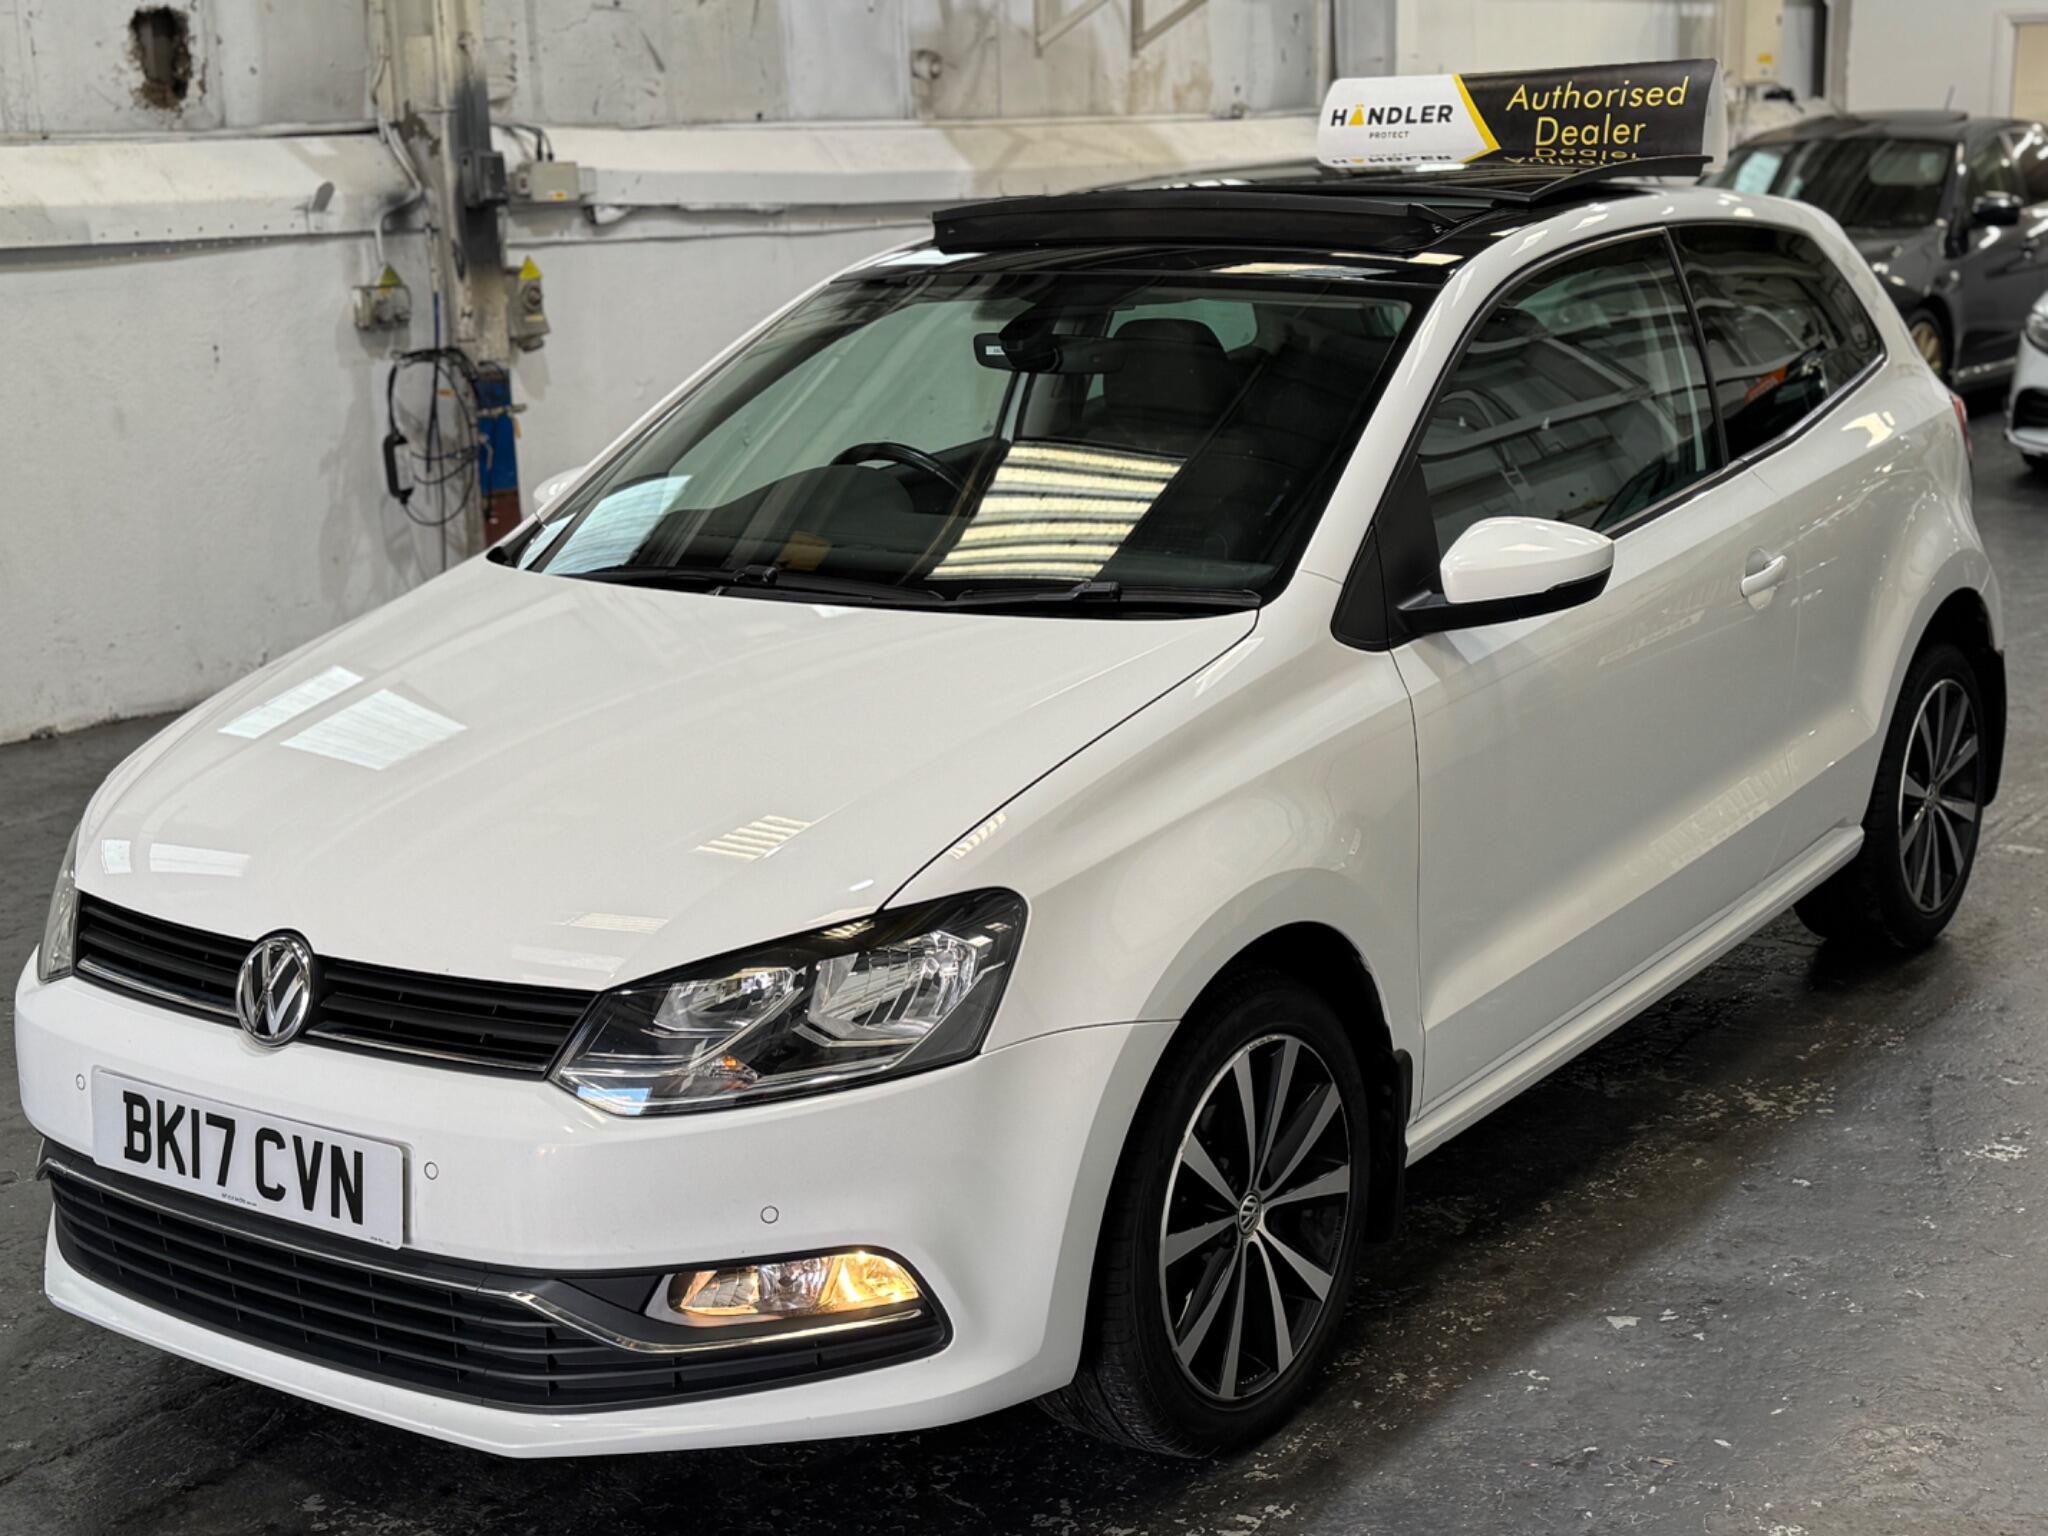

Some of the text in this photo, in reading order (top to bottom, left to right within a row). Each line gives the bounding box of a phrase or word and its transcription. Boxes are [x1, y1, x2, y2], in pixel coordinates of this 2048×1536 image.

[1506, 76, 1689, 111] Authorised
[1369, 131, 1409, 139] PROTECT
[1535, 113, 1646, 146] Dealer
[122, 1090, 364, 1226] BK17 CVN
